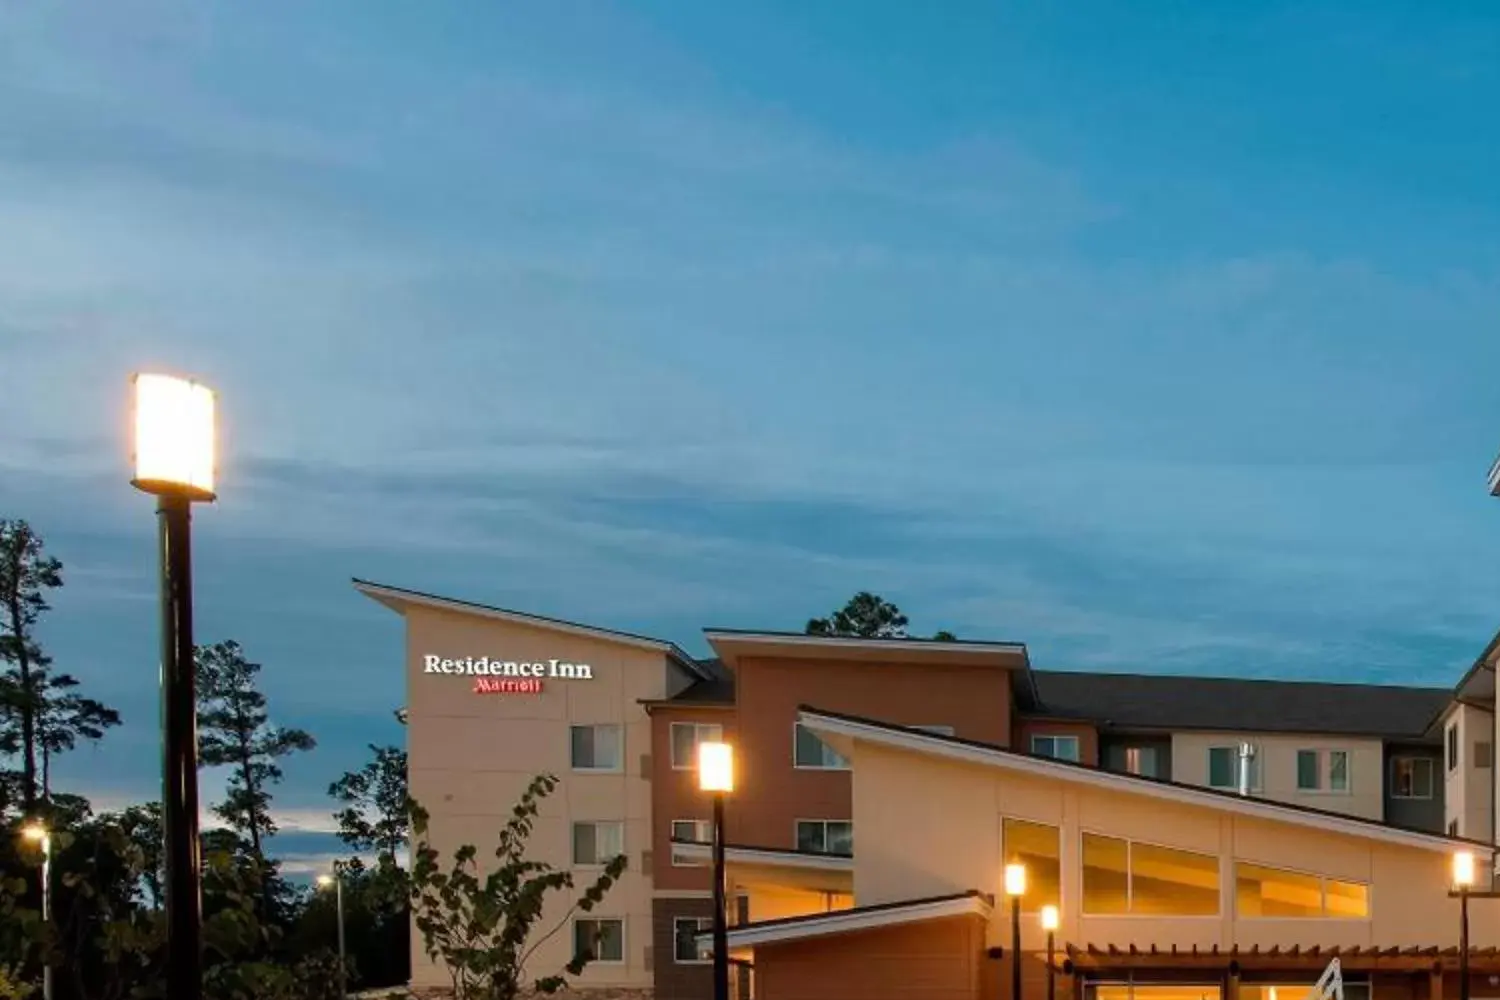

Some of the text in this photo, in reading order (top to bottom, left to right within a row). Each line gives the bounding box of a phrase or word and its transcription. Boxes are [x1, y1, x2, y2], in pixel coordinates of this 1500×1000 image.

[423, 655, 592, 679] Residence Inn
[473, 678, 542, 692] Marriott
